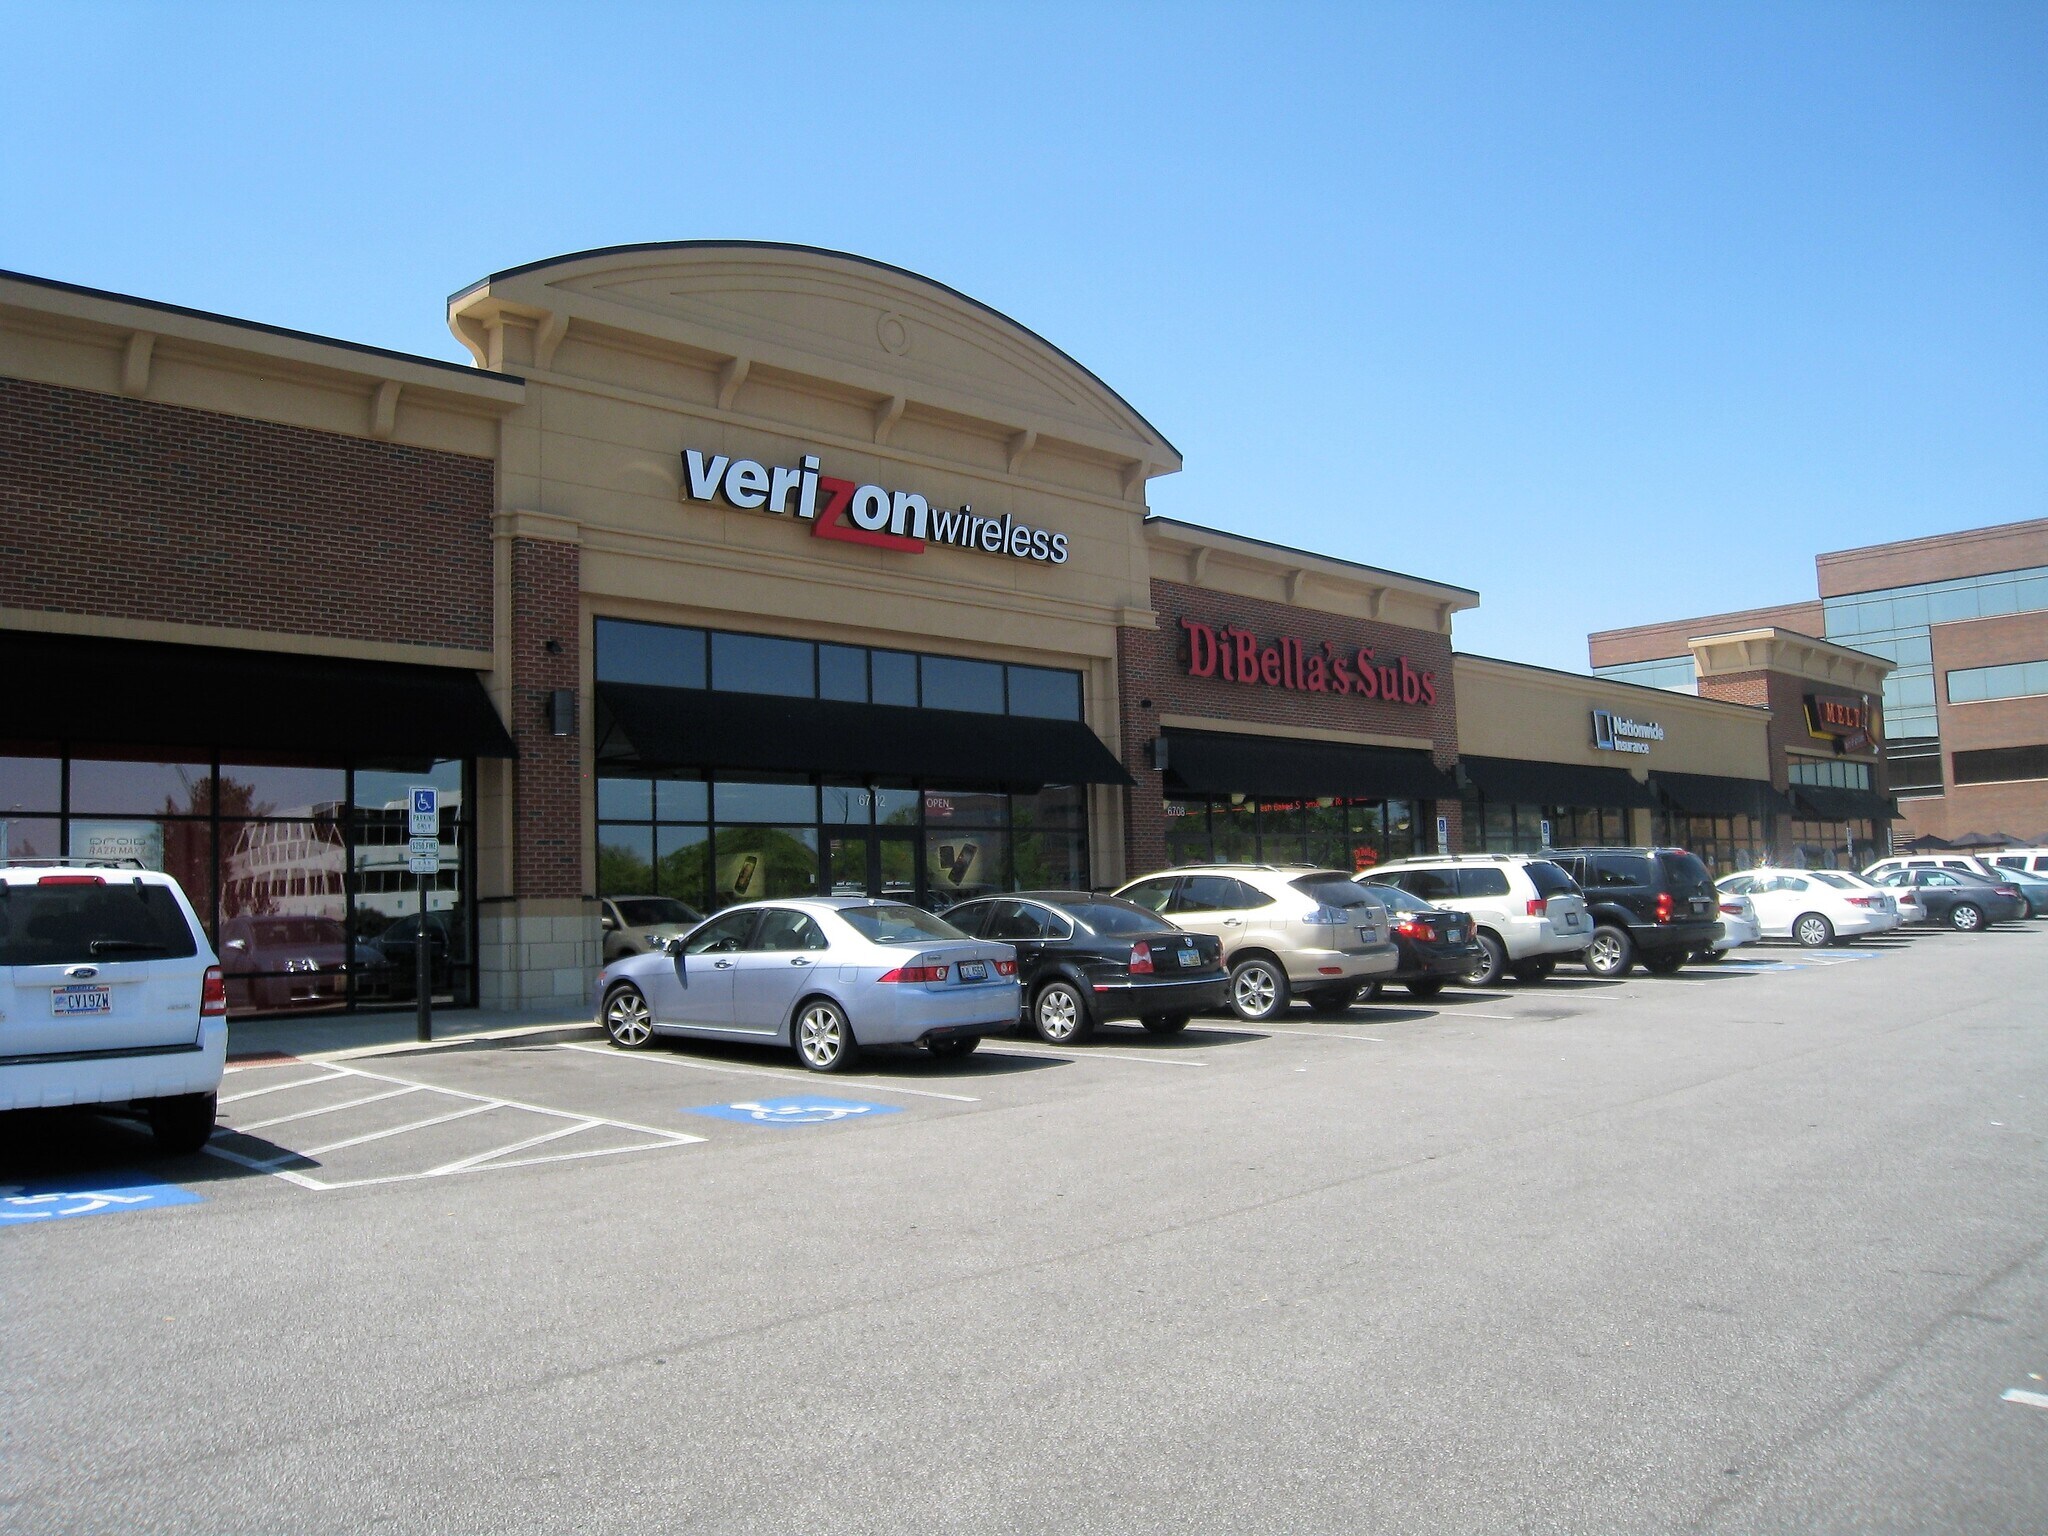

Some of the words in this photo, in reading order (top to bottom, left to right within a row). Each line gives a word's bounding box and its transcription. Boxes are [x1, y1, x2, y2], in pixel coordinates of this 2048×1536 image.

[681, 449, 928, 555] verizon
[928, 504, 1069, 564] wireless
[1179, 616, 1351, 695] DiBella's
[1354, 648, 1437, 706] Subs
[1825, 701, 1861, 728] MELT
[1613, 716, 1664, 740] Nationwide
[1613, 736, 1650, 754] Insurance
[858, 794, 886, 807] 6712
[926, 798, 950, 808] OPEN
[1167, 806, 1186, 817] 6708
